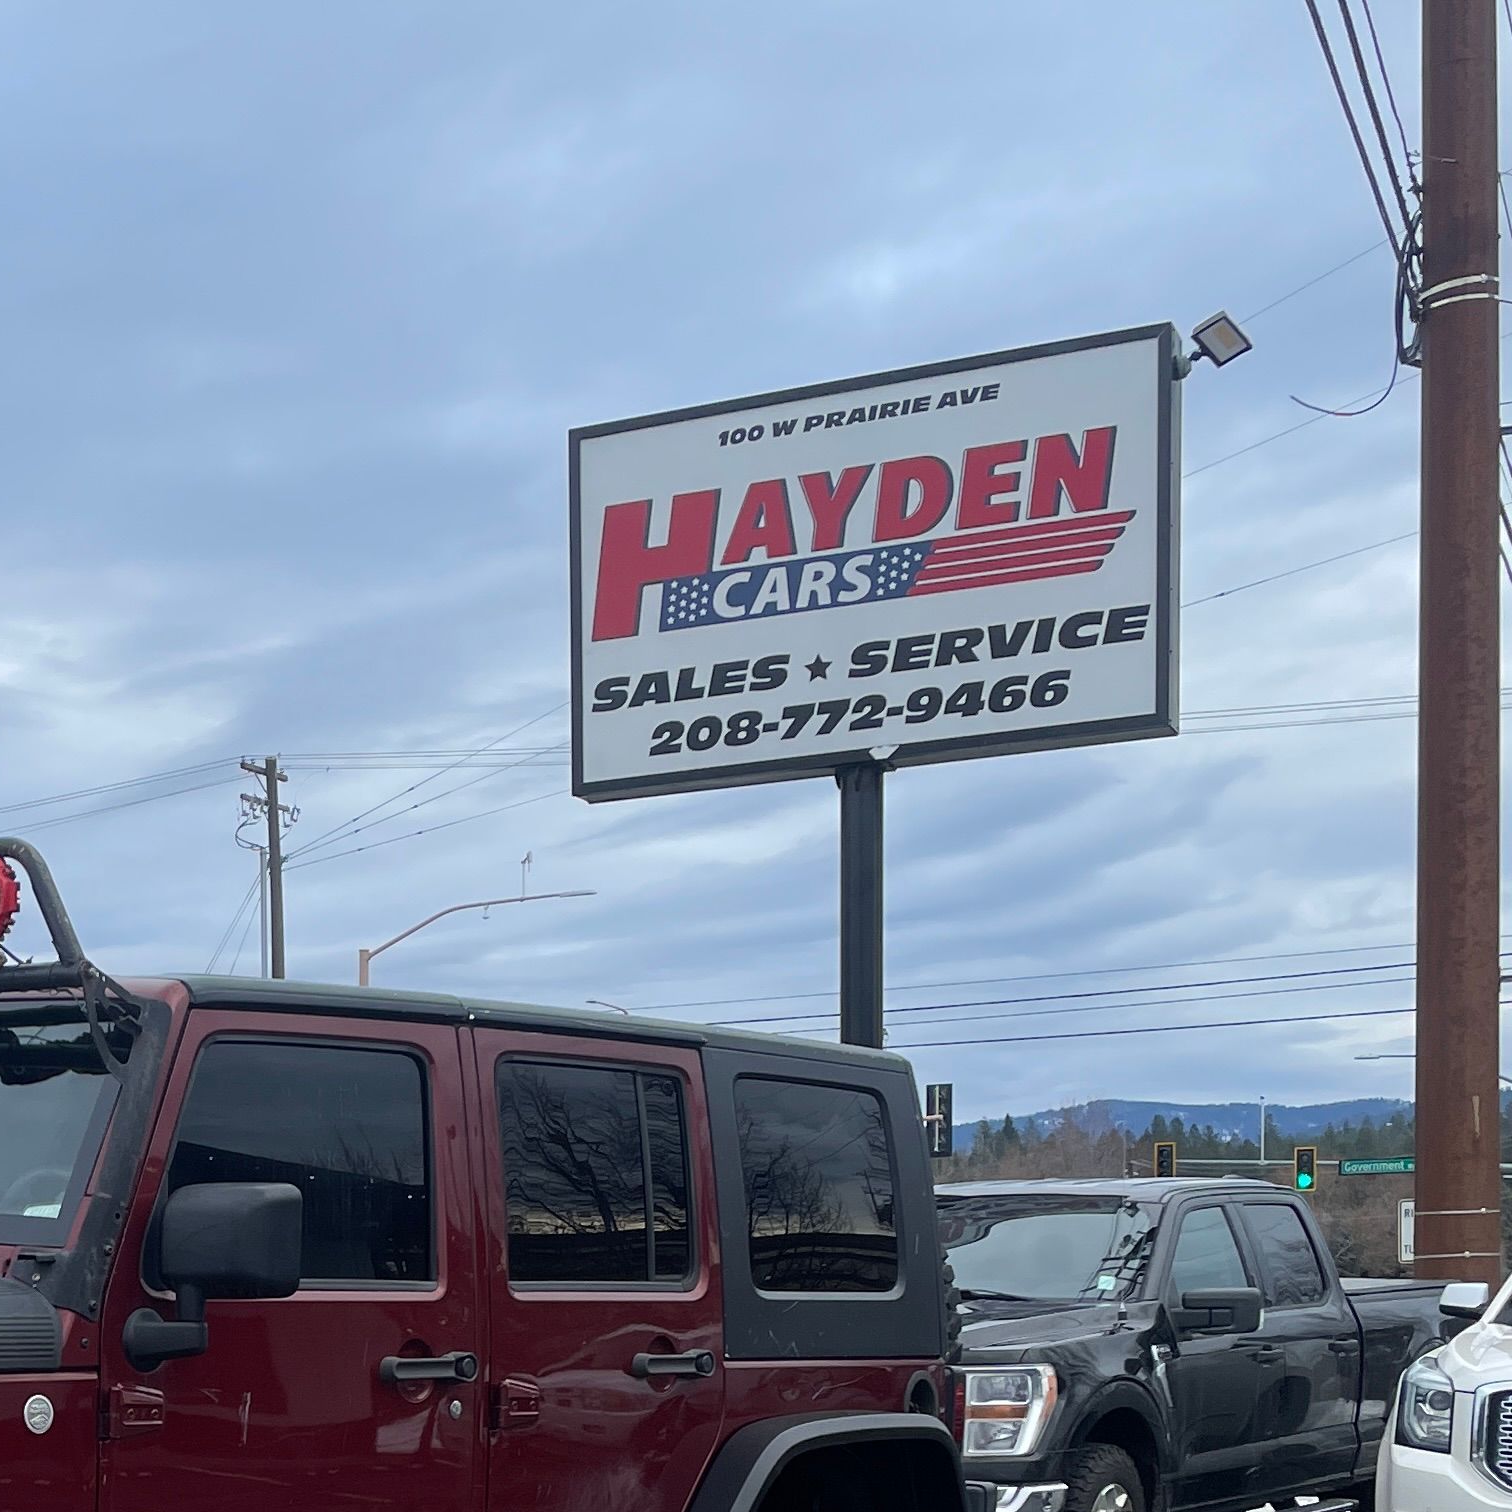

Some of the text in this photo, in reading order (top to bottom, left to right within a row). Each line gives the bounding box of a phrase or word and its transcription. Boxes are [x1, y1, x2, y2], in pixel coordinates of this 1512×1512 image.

[718, 383, 1001, 447] 100 W PRAIRIE AVE
[591, 425, 1118, 641] HAYDEN
[712, 552, 876, 620] CARS
[591, 604, 1151, 712] SALES SERVICE
[648, 669, 1072, 756] 208-772-9466
[1344, 1160, 1405, 1172] Government
